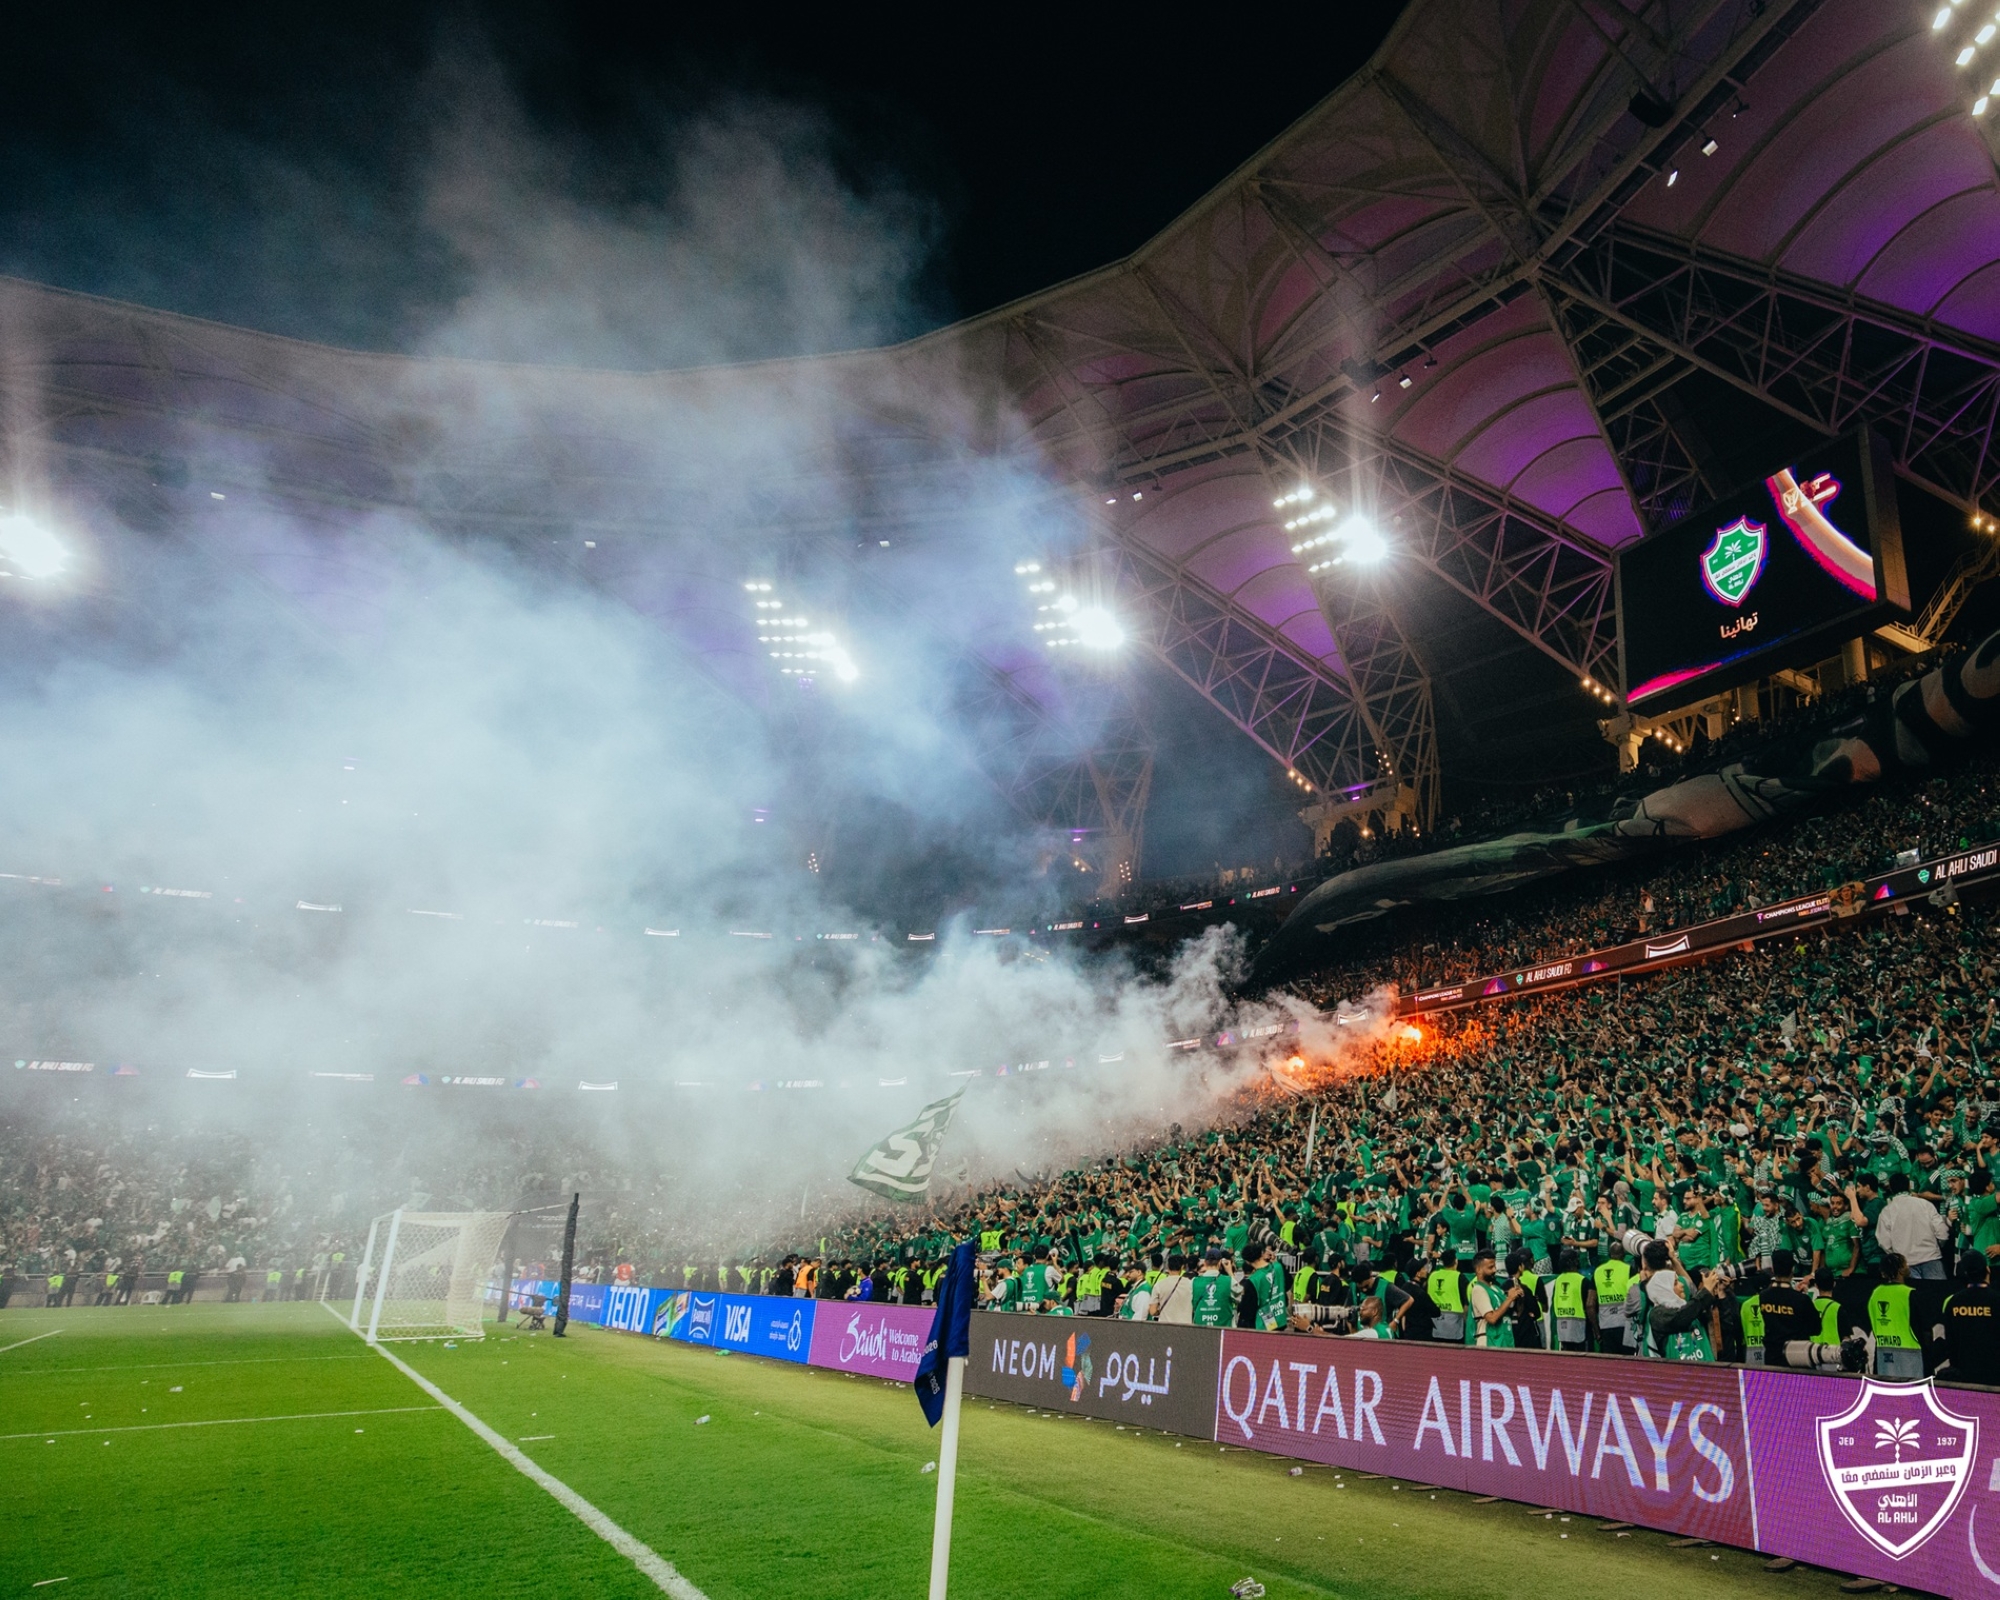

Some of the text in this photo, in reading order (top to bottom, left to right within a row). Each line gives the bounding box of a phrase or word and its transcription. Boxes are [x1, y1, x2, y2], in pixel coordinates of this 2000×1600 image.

[1720, 611, 1758, 638] تهانينا
[1935, 849, 1998, 880] AL AHLI SAUDI
[1765, 906, 1796, 919] CHAMPIONS
[1796, 900, 1816, 912] LEAGUE
[1525, 962, 1573, 983] AL AHLI SAUDI FC
[58, 1062, 83, 1071] SAUDI
[81, 1063, 95, 1072] FC
[605, 1285, 651, 1333] TECNO
[1201, 1314, 1218, 1322] PHO
[1760, 1303, 1794, 1316] POLICE
[1952, 1305, 1991, 1317] POLICE
[724, 1304, 752, 1343] VISA
[889, 1328, 919, 1347] Welcome
[891, 1347, 922, 1364] to Arabia
[992, 1338, 1056, 1381] NEOM
[1099, 1346, 1172, 1406] نيوم
[1221, 1354, 1736, 1504] QATAR AIRWAYS
